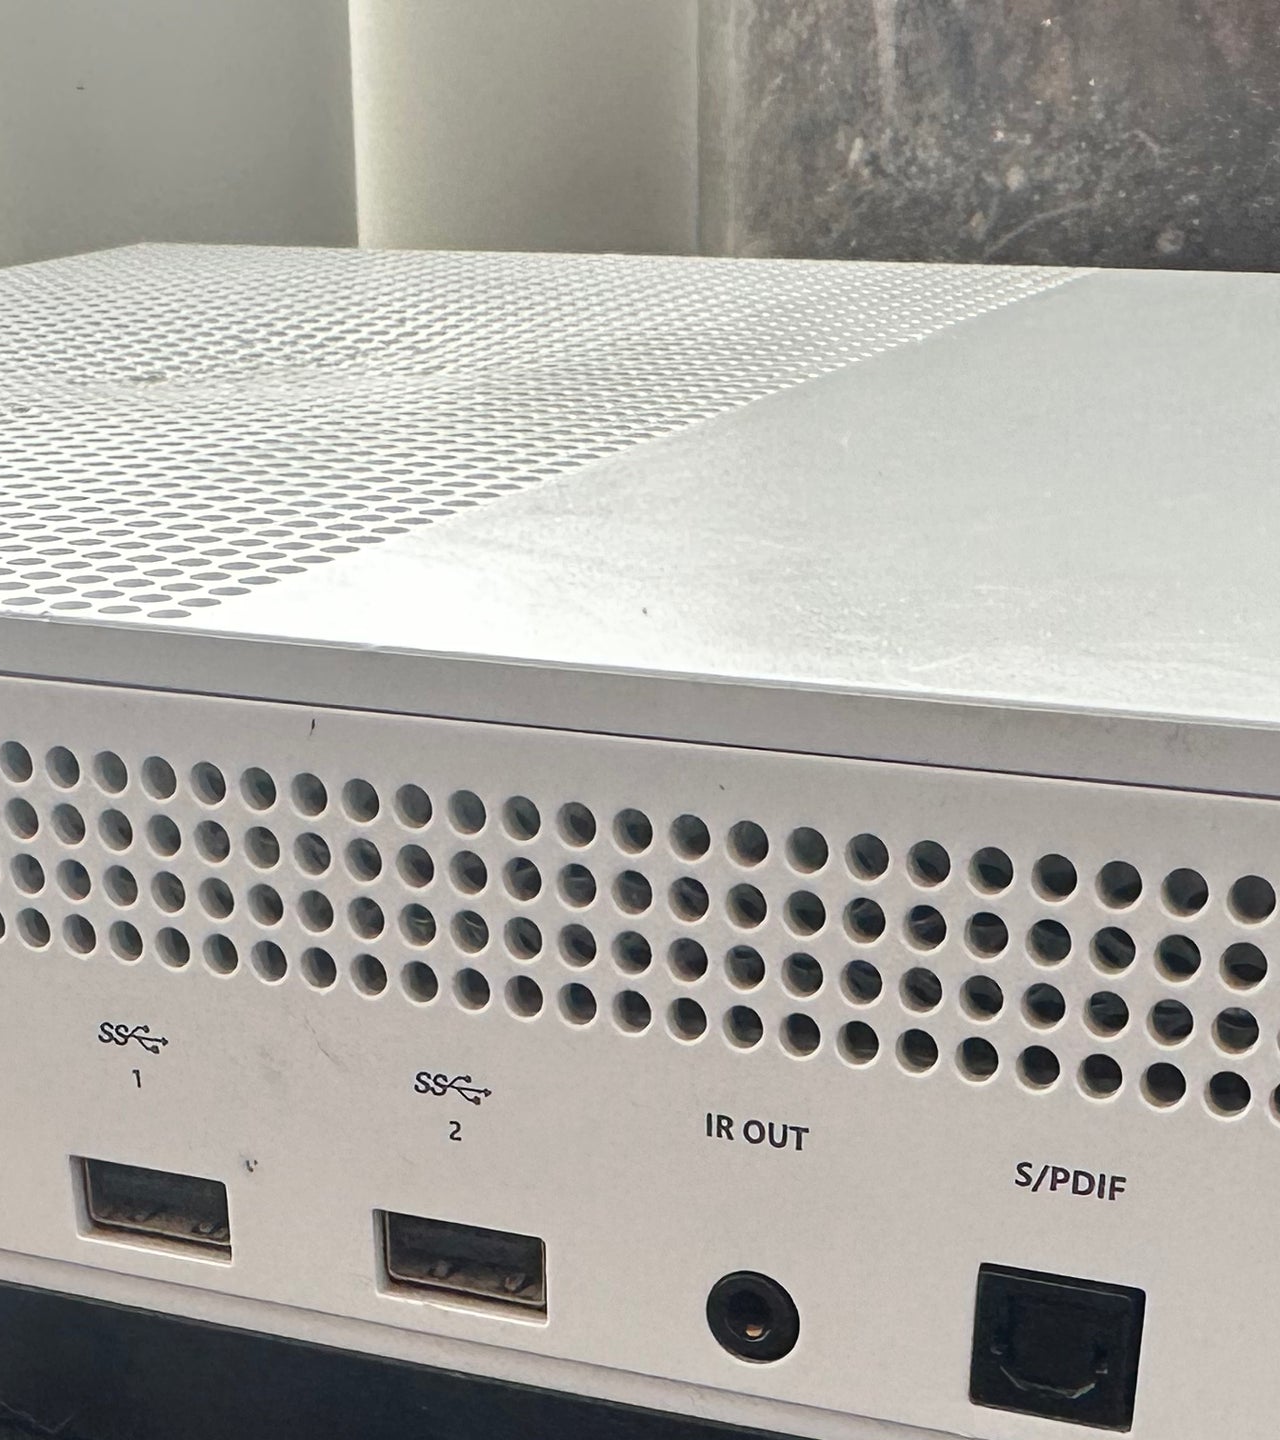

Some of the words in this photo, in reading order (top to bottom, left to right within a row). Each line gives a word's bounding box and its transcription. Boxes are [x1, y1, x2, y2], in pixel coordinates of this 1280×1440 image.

[132, 1069, 141, 1089] 1
[449, 1121, 462, 1142] 2
[706, 1113, 733, 1141] IR
[743, 1119, 809, 1151] OUT
[1015, 1162, 1127, 1201] S/PDIF
